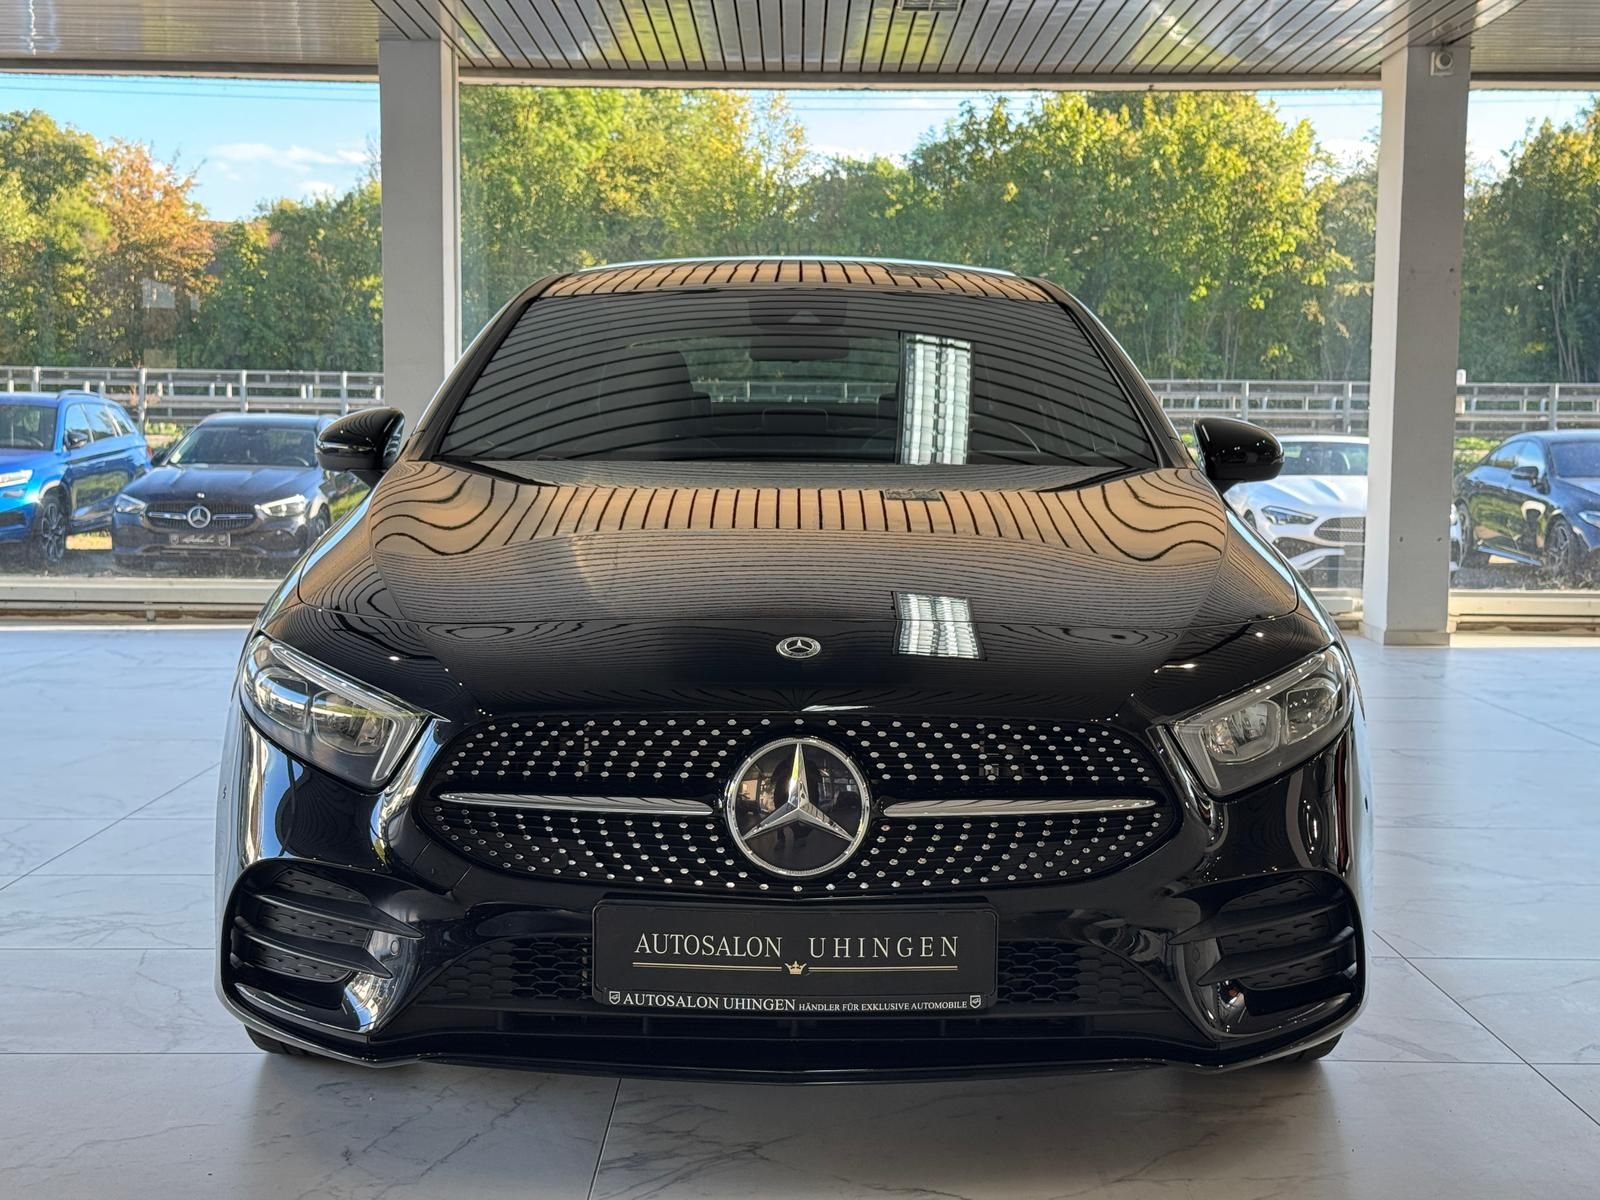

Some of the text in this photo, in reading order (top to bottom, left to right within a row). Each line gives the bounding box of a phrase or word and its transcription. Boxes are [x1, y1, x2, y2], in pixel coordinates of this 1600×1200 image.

[634, 933, 960, 958] AUTOSALON UHINGEN
[623, 993, 968, 1012] AUTOSALON UHINGEN HÄNDLER FÜR EXKLUSIVE AUTOMOBILE
